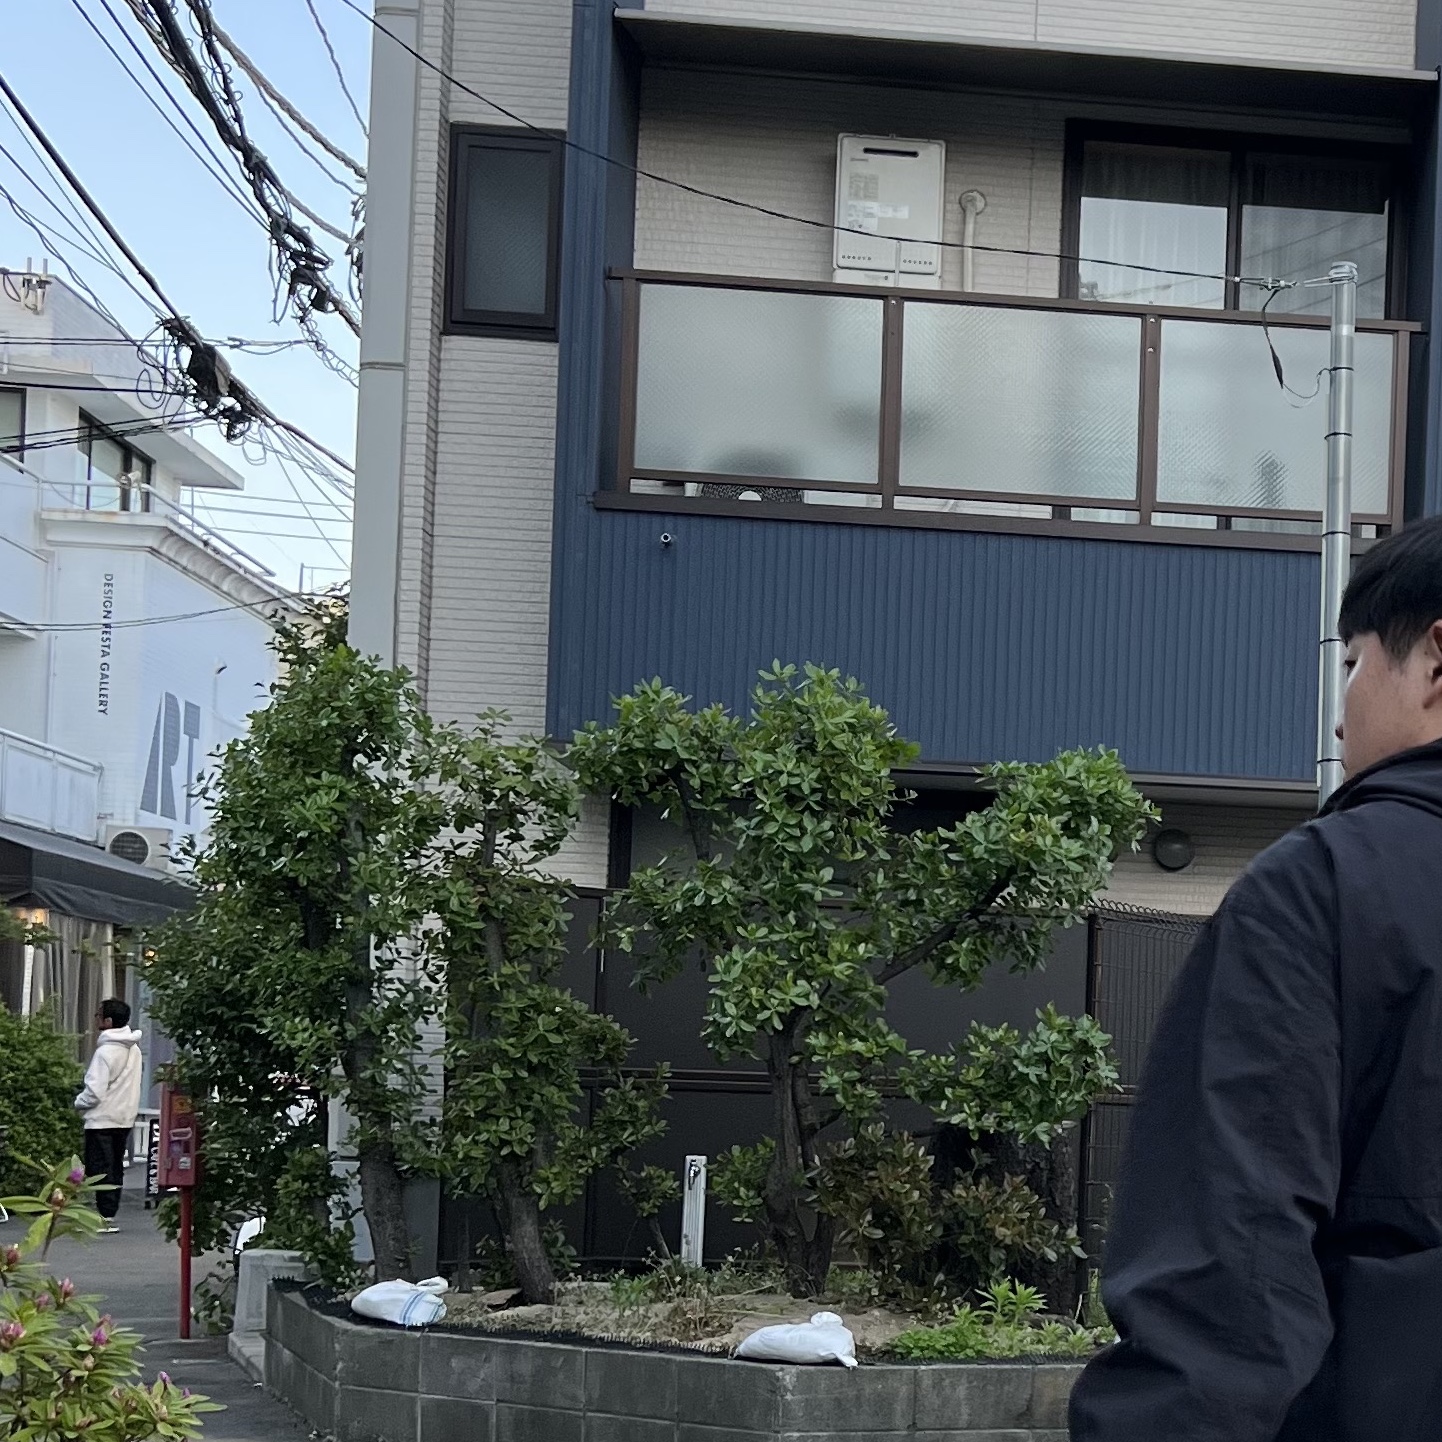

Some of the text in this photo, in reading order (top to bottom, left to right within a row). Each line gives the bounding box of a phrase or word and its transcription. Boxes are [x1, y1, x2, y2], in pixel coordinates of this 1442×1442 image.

[97, 573, 114, 715] DESIGN FESTA GALLERY
